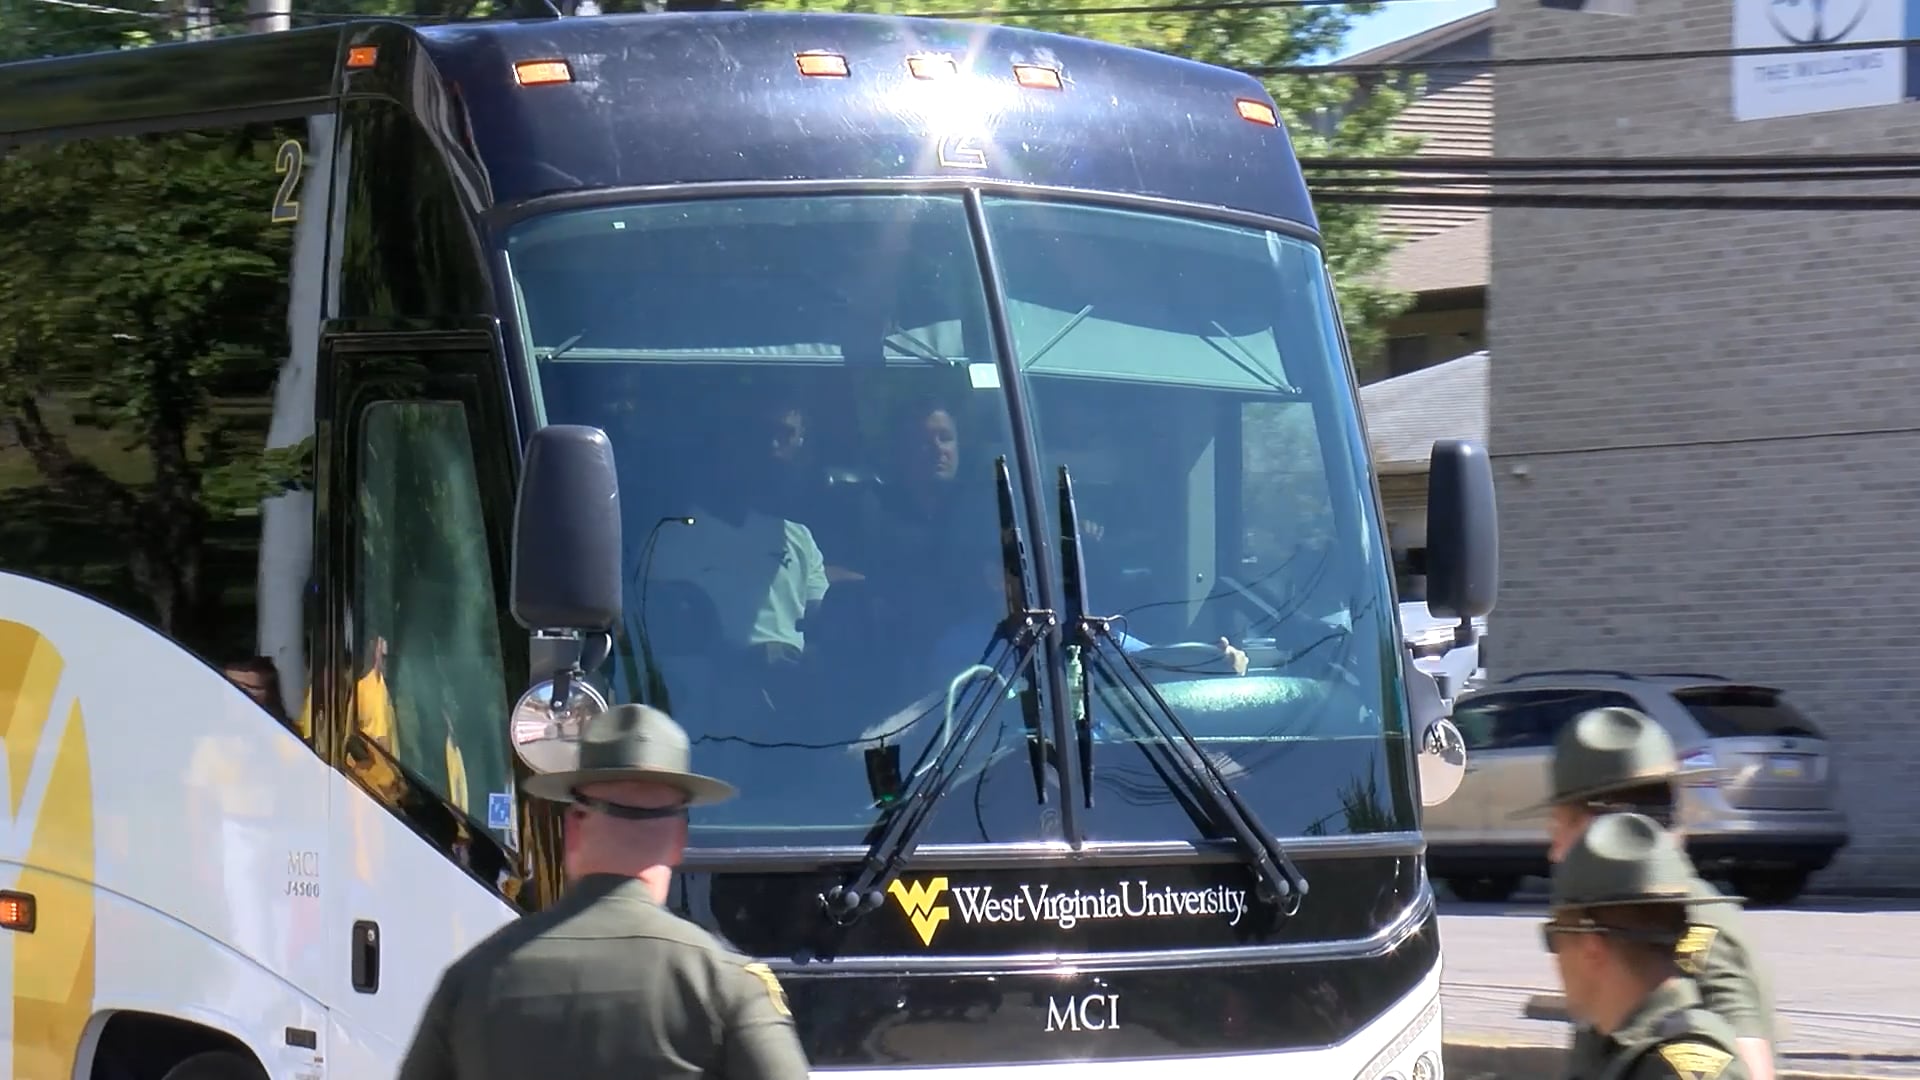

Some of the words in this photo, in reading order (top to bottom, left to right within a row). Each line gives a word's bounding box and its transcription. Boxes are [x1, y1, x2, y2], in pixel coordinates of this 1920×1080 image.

[1754, 63, 1789, 82] THE
[272, 139, 303, 222] 2
[287, 850, 319, 877] MCI
[284, 881, 320, 897] J4500
[1044, 994, 1120, 1032] MCI
